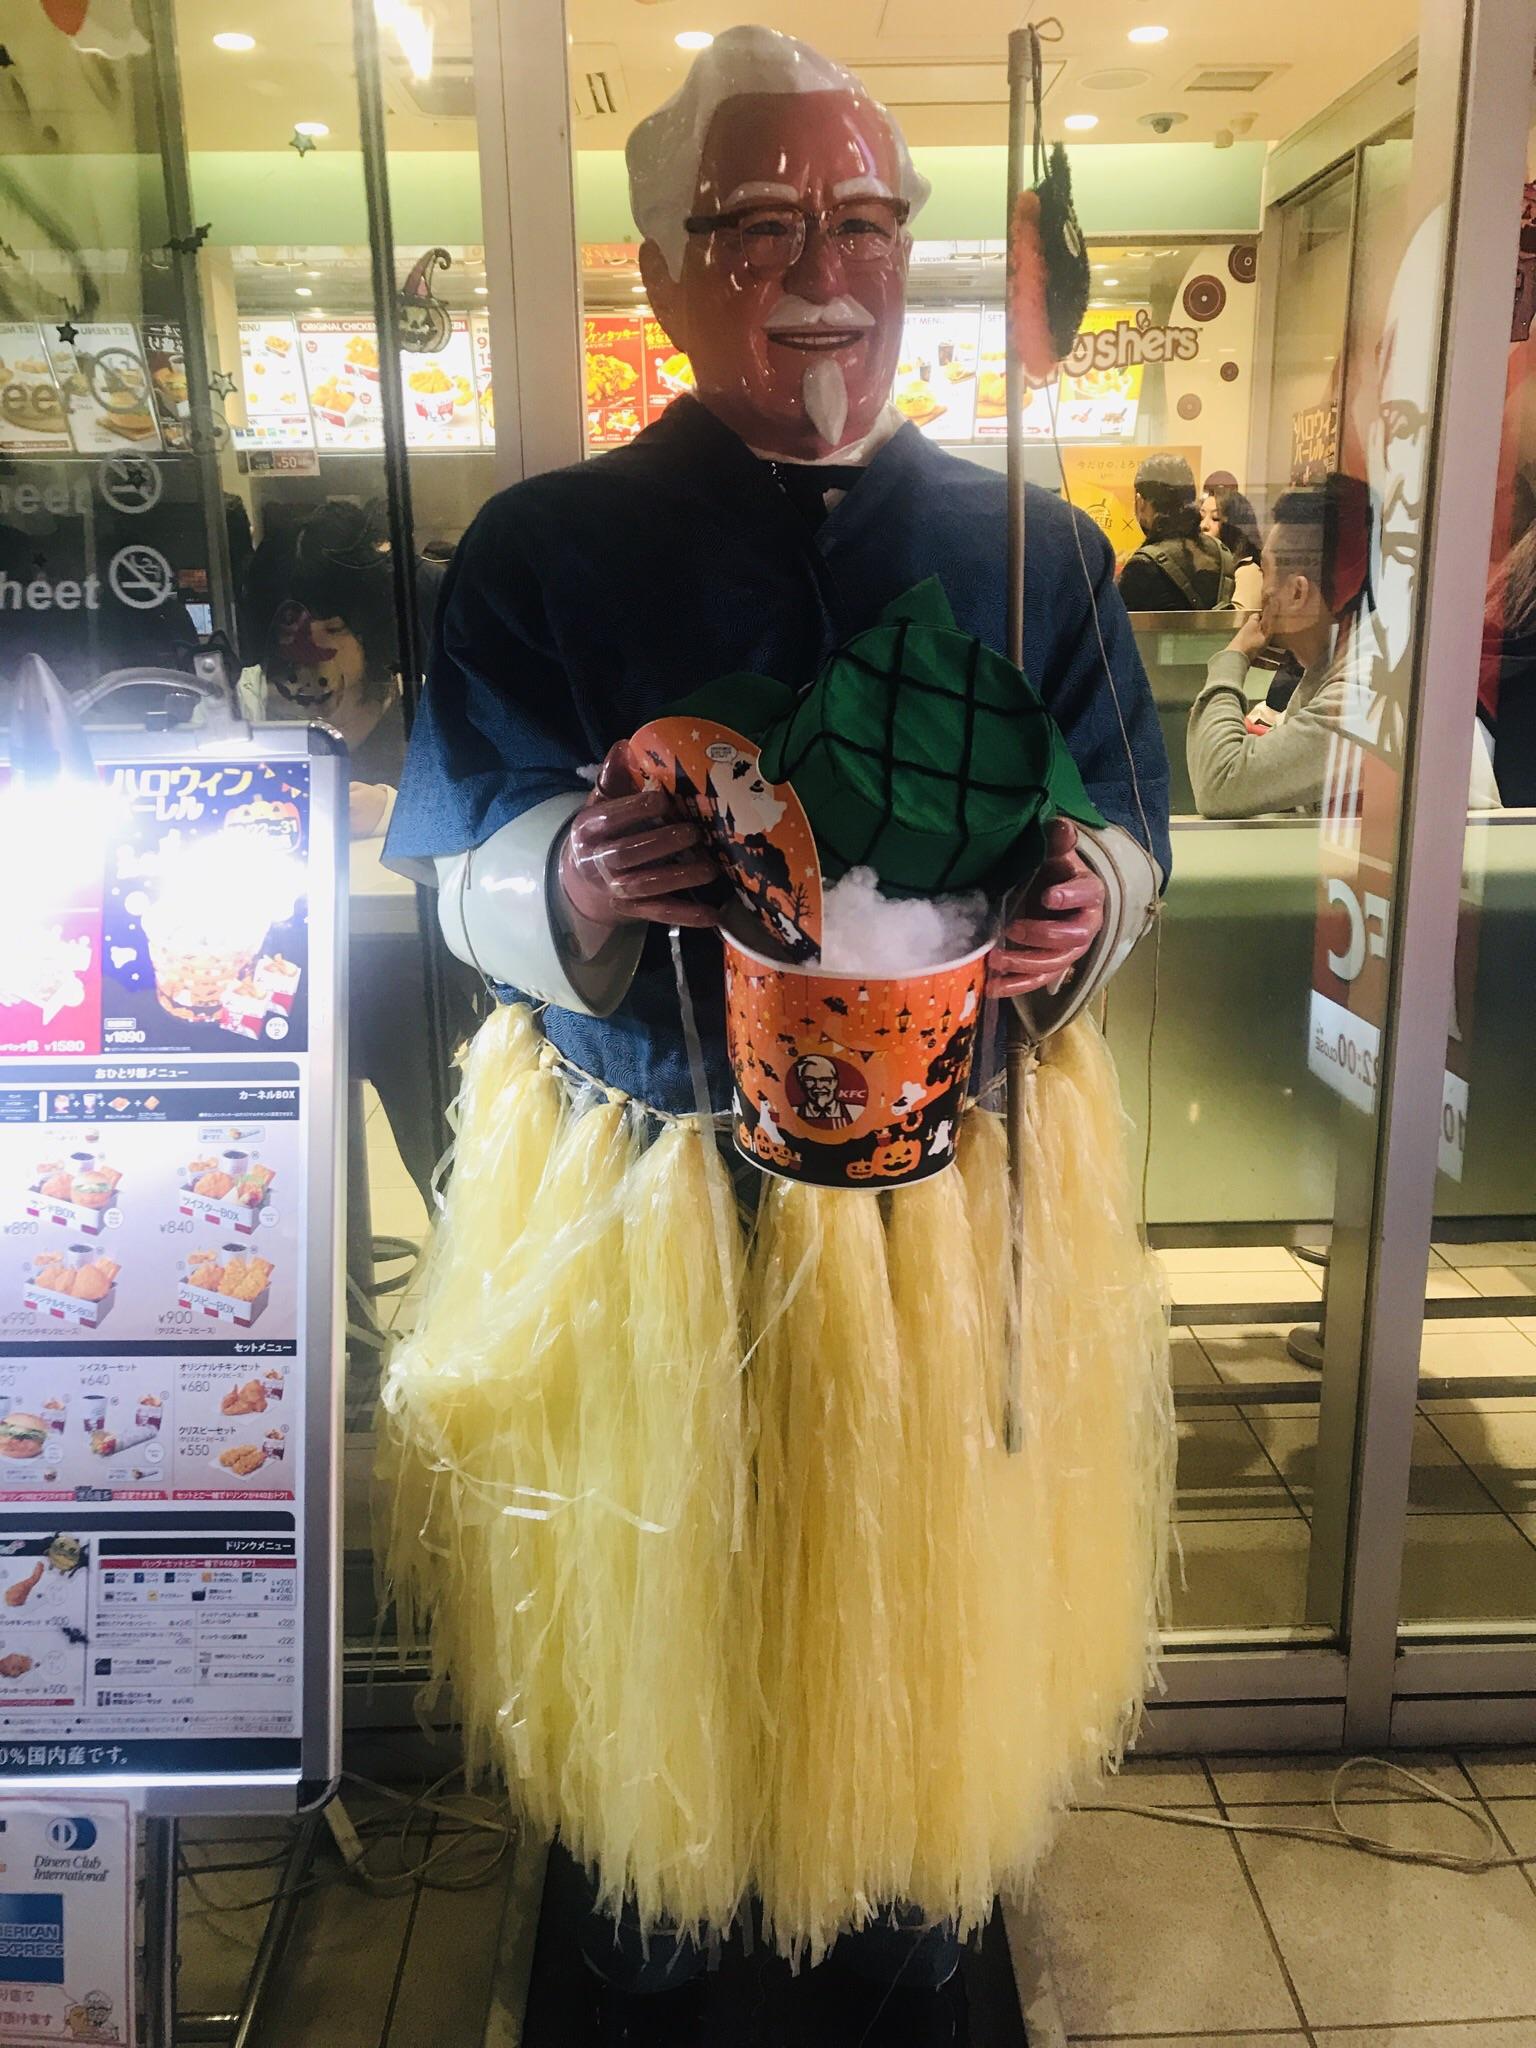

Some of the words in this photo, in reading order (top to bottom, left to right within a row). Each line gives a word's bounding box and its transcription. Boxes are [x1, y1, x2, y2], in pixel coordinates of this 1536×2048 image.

[301, 322, 341, 331] ORIGINAL
[112, 767, 253, 798] ハロウィン
[838, 1089, 867, 1099] KFC
[160, 1219, 194, 1234] ¥840
[158, 1311, 193, 1325] ¥900
[234, 1342, 292, 1353] セットメニュー
[180, 1444, 210, 1456] ¥550
[225, 1541, 292, 1551] ドリンクメニュー
[34, 1855, 70, 1868] Diners
[73, 1855, 101, 1869] Club
[34, 1868, 109, 1882] International
[0, 1924, 58, 1939] ERICAN
